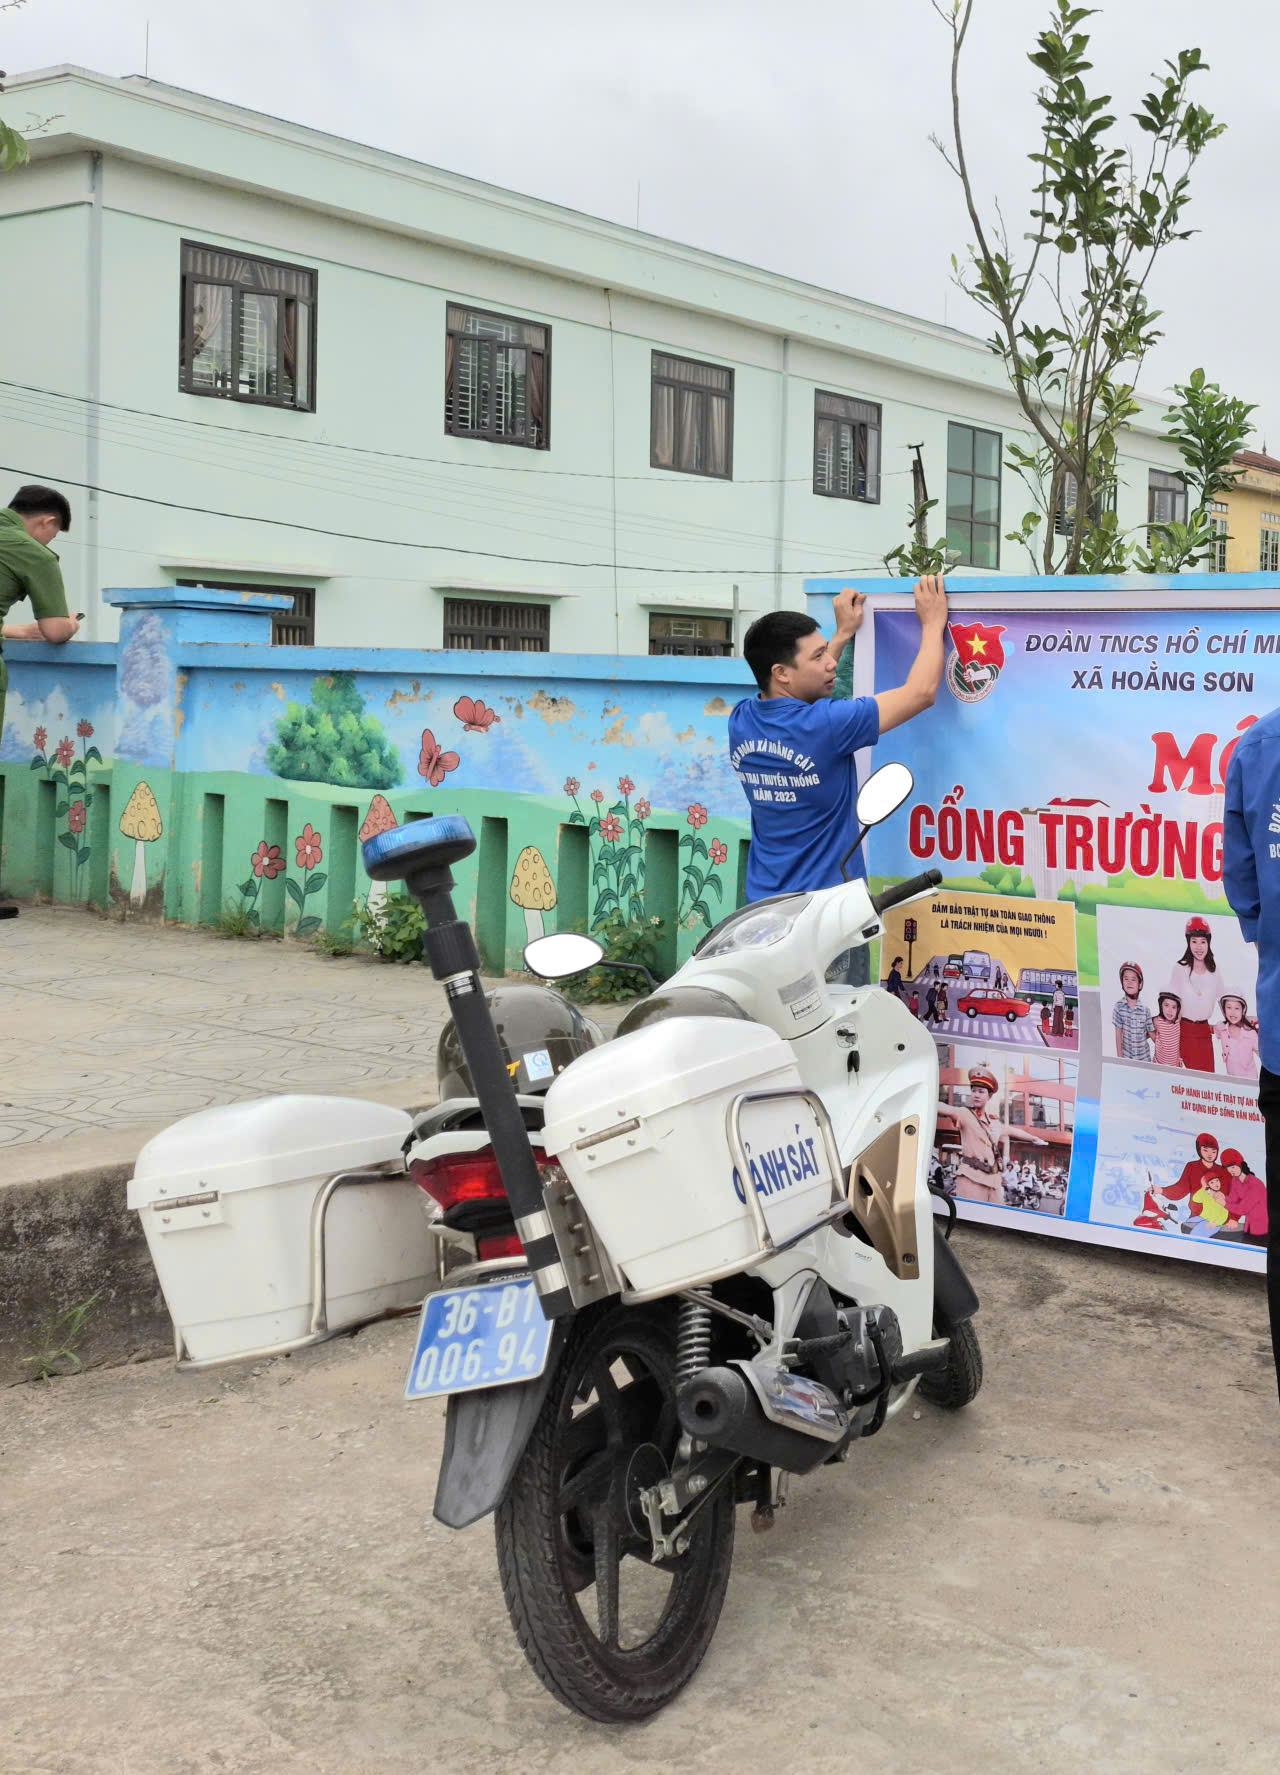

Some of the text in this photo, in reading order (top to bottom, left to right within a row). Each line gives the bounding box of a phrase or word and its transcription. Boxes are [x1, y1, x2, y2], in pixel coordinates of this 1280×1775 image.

[1025, 630, 1092, 653] ĐOÀN
[1099, 635, 1158, 654] TNCS
[1165, 626, 1200, 654] HỒ
[1206, 629, 1249, 654] CHÍ
[1071, 661, 1254, 692] XÃ HOẰNG SƠN
[793, 753, 816, 772] CÁT
[774, 790, 798, 803] 2023
[909, 784, 1025, 866] CỔNG
[963, 904, 979, 918] TRẬT
[980, 907, 989, 919] TỰ
[990, 909, 999, 919] AN
[1000, 909, 1017, 921] TOÀN
[1017, 911, 1033, 922] GIAO
[1033, 912, 1056, 925] THÔNG
[940, 917, 949, 929] LÀ
[950, 919, 972, 931] TRÁCH
[973, 921, 995, 934] NHIỆM
[995, 922, 1009, 934] CỦA
[1009, 926, 1022, 938] MỌI
[1245, 1097, 1254, 1107] AN
[437, 1284, 537, 1339] 36-B1
[414, 1327, 537, 1392] 006.94
